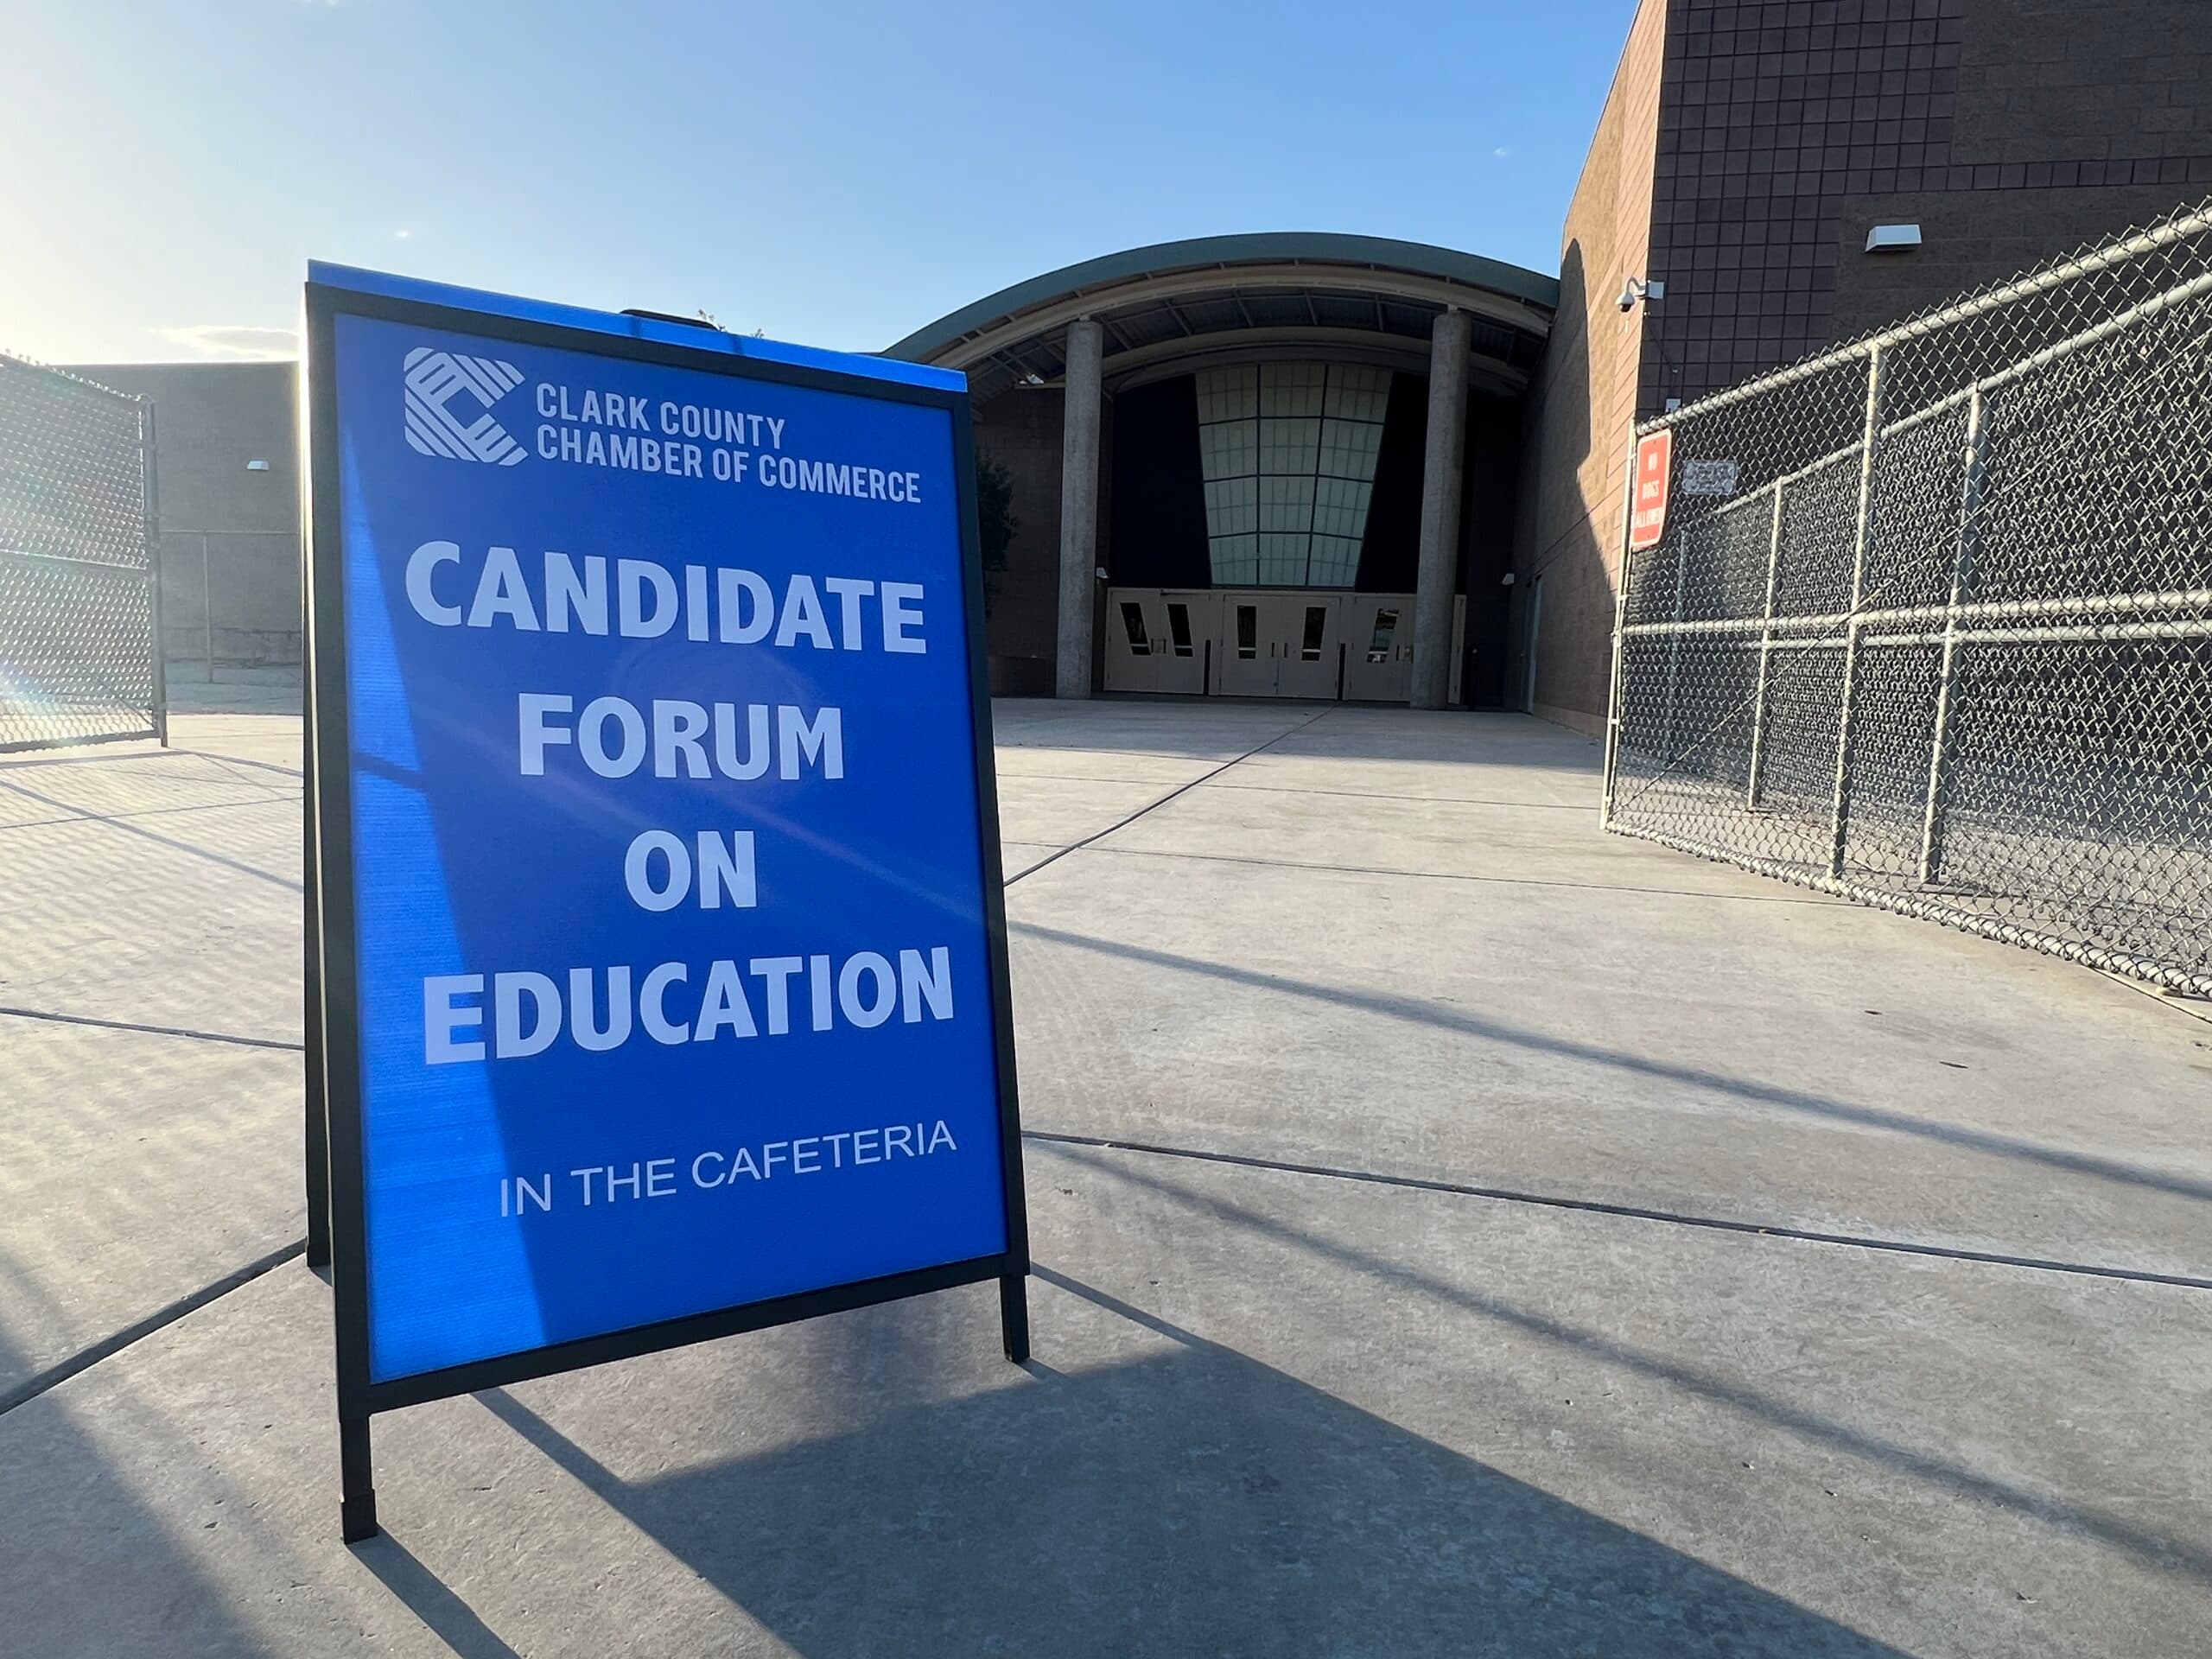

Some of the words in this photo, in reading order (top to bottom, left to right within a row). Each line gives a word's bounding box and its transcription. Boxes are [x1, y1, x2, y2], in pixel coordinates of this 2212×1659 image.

[537, 383, 650, 431] CLARK
[661, 402, 785, 449] COUNTY
[537, 424, 702, 478] CHAMBER
[713, 448, 749, 482] OF
[760, 454, 921, 503] COMMERCE
[1642, 480, 1660, 500] DOGS
[405, 541, 926, 654] CANDIDATE
[518, 693, 843, 780] FORUM
[625, 830, 757, 912] ON
[424, 946, 954, 1065] EDUCATION
[501, 1173, 550, 1217] IN
[570, 1158, 677, 1205] THE
[692, 1120, 957, 1187] CAFETERIA
